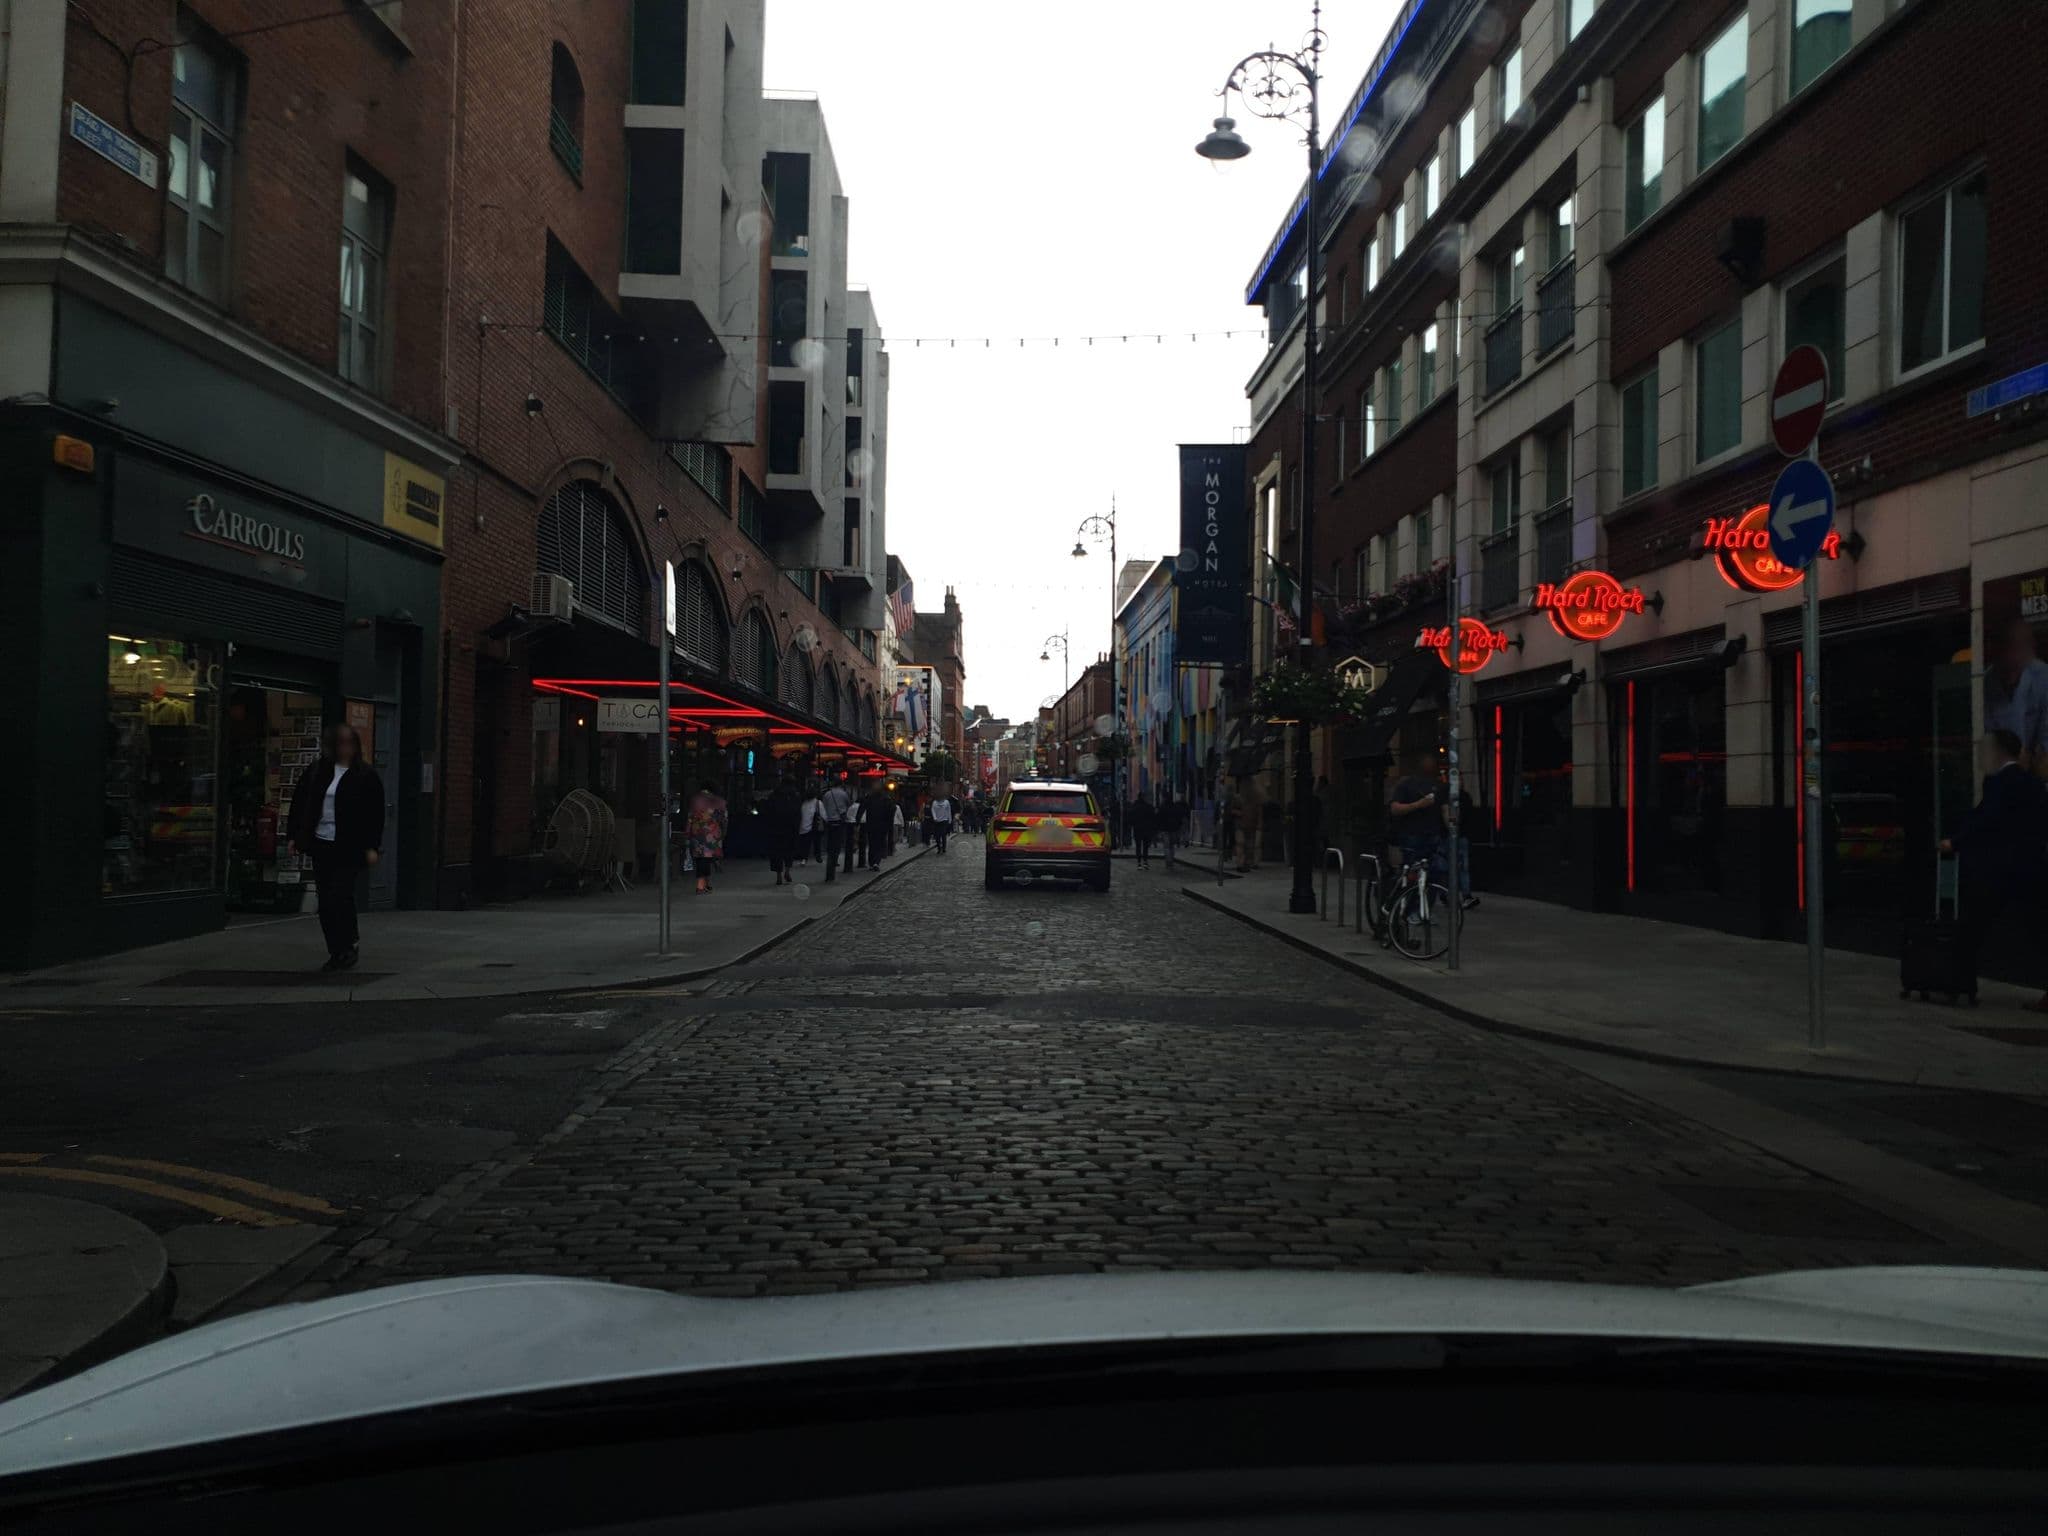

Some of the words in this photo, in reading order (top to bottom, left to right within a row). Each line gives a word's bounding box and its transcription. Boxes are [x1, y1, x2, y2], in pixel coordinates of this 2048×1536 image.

[184, 494, 305, 561] CARROLLS
[1204, 472, 1221, 573] MORGAN
[1536, 583, 1591, 608] Hard
[1593, 584, 1645, 614] Rock
[1577, 613, 1609, 625] CAFE
[1466, 629, 1508, 653] Rock
[1459, 650, 1478, 662] AFE
